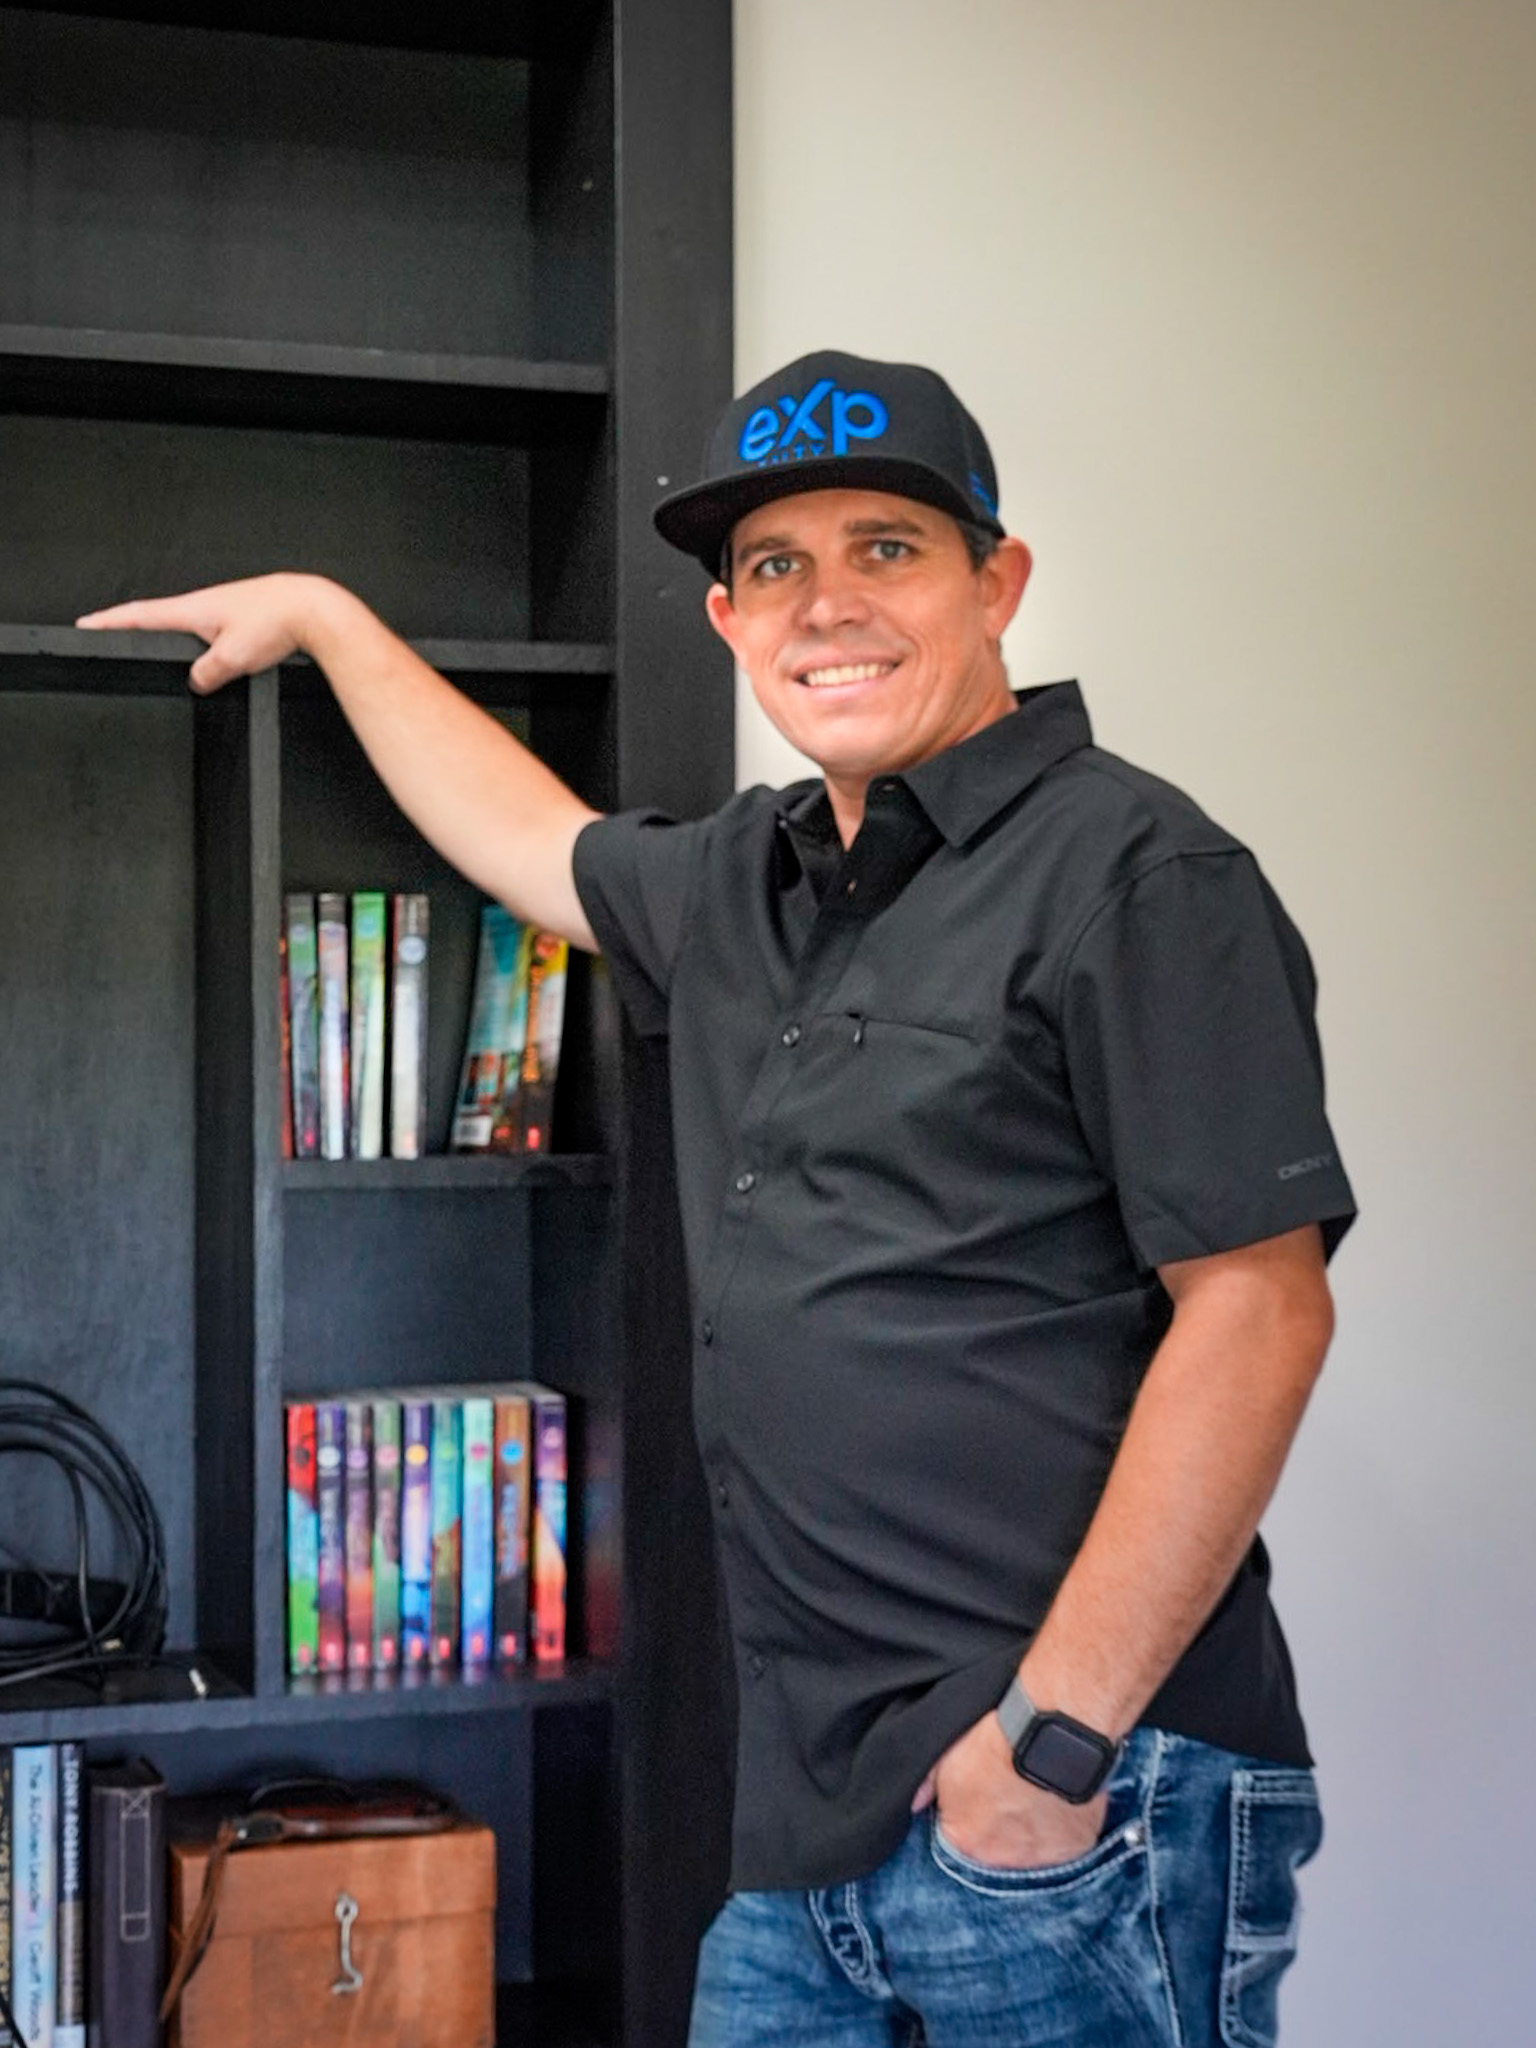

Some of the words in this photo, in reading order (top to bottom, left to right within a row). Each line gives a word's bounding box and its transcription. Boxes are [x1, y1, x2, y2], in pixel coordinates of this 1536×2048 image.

[29, 1764, 43, 1790] The
[63, 1759, 80, 1809] TONY
[63, 1812, 80, 1893] ROBBINS
